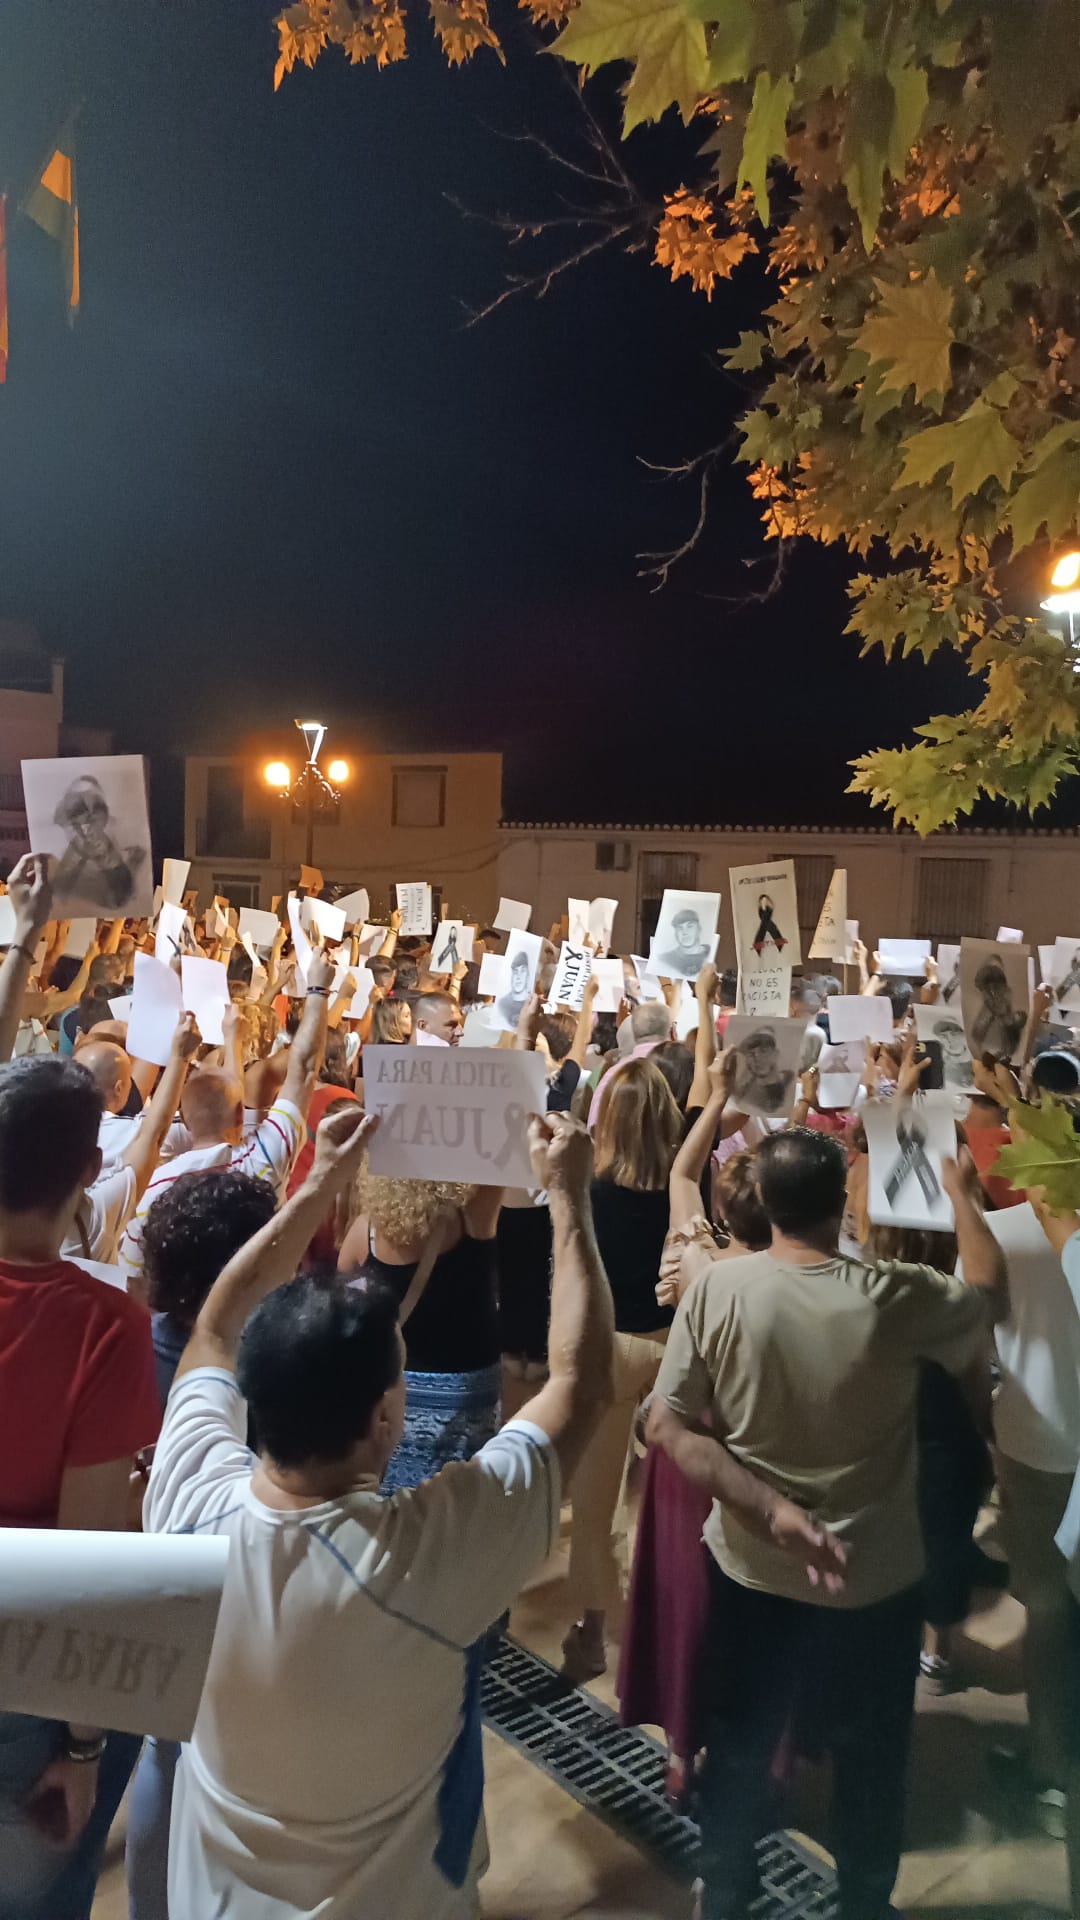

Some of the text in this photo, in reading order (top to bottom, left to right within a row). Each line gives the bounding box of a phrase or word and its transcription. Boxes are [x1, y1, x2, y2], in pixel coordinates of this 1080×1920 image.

[557, 960, 582, 1001] JUAN
[748, 976, 779, 988] NO ES
